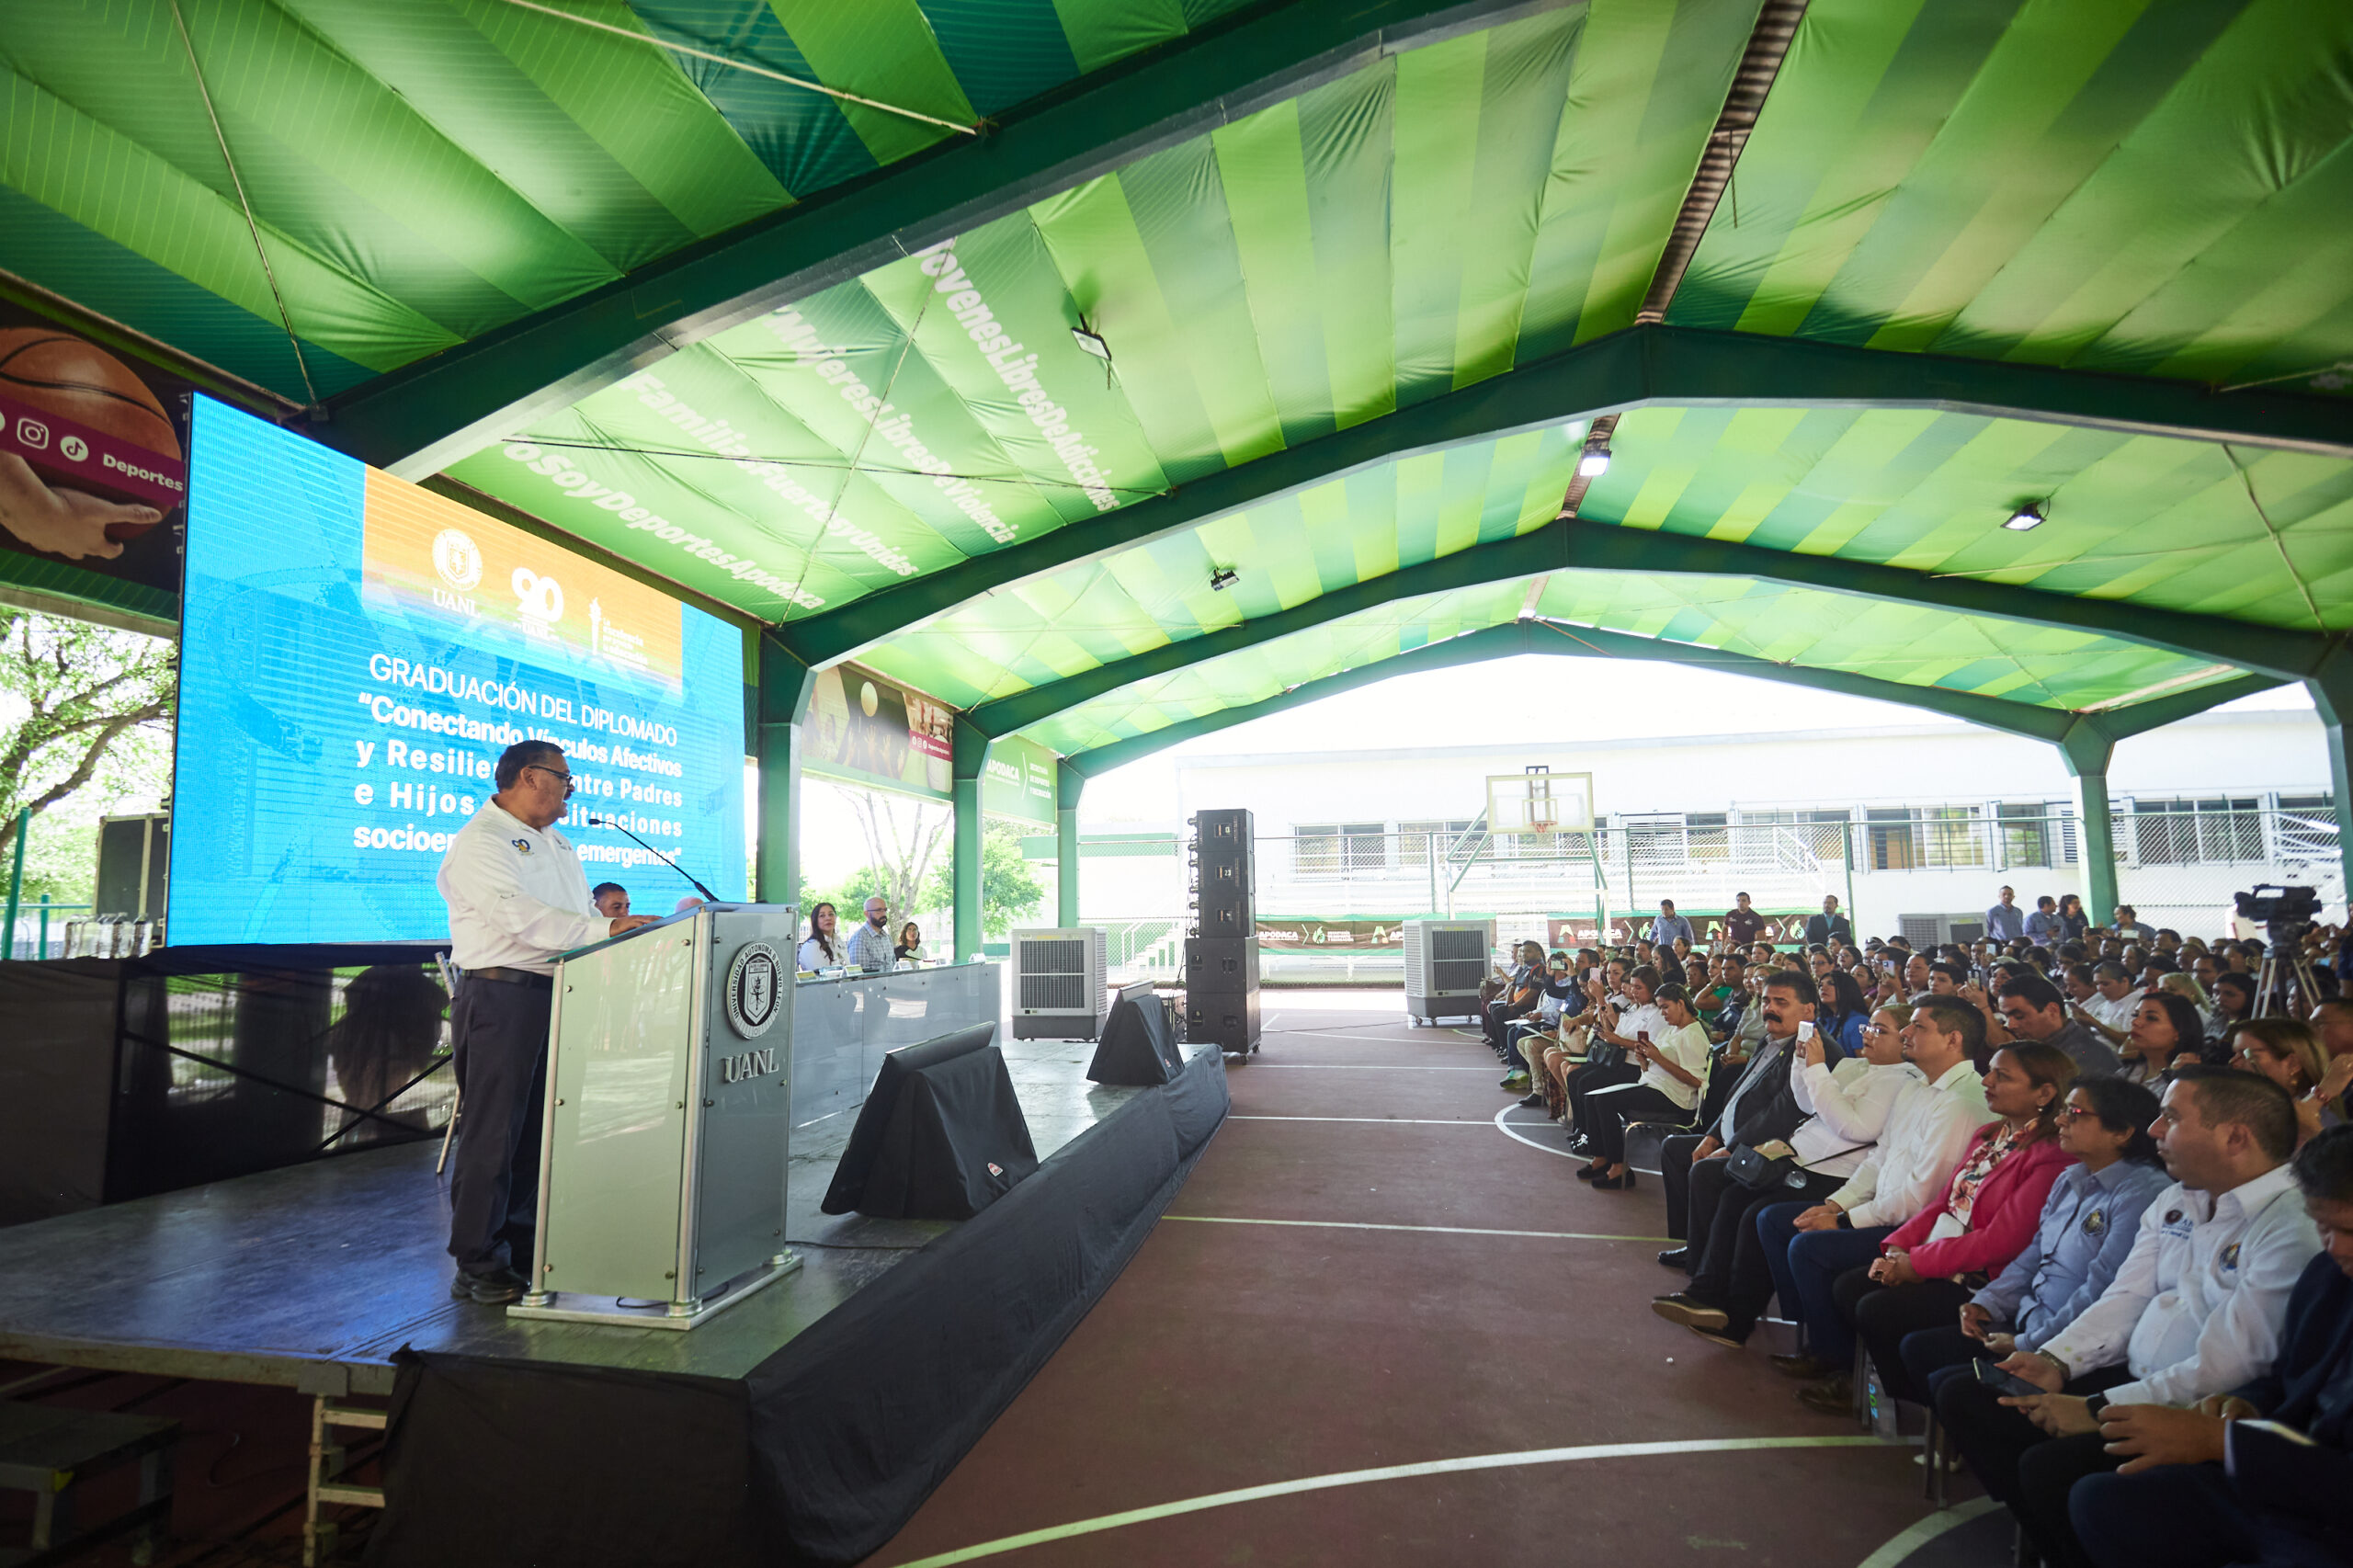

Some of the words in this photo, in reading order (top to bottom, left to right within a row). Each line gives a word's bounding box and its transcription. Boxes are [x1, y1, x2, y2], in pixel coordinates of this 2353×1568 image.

[103, 453, 184, 492] Deportes
[503, 434, 825, 609] oSoyDeportesApodaca
[432, 588, 481, 618] UANL
[369, 653, 537, 715] GRADUACIÓN
[540, 694, 577, 725] DEL
[581, 705, 677, 747] DIPLOMADO
[356, 740, 375, 767] y
[387, 739, 498, 779] Resilie
[570, 773, 614, 797] ntre
[620, 778, 683, 807] Padres
[610, 744, 682, 778] Afectivos
[986, 758, 1020, 781] APODACA
[354, 783, 374, 805] e
[390, 781, 475, 817] Hijos
[1577, 929, 1623, 937] APOCA
[731, 958, 745, 1019] UNIVERSIDAD
[745, 944, 772, 959] AUTONOMA
[723, 1048, 779, 1084] UANL
